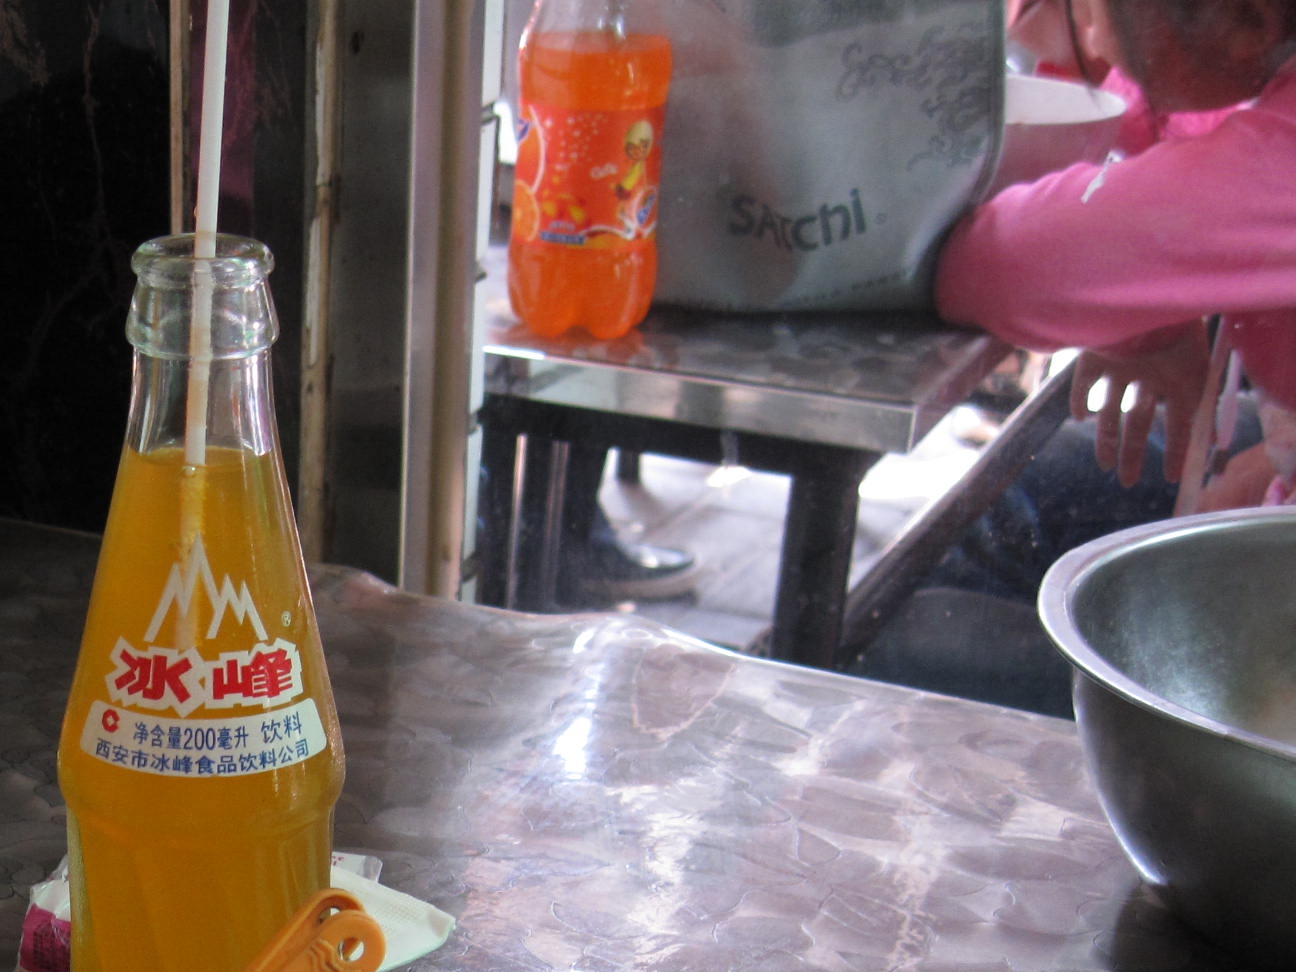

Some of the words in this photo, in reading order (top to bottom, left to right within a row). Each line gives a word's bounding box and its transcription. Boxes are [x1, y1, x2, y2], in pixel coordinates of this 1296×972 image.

[114, 648, 294, 704] 冰峰
[95, 738, 310, 774] 西安市冰峰食品饮料公司
